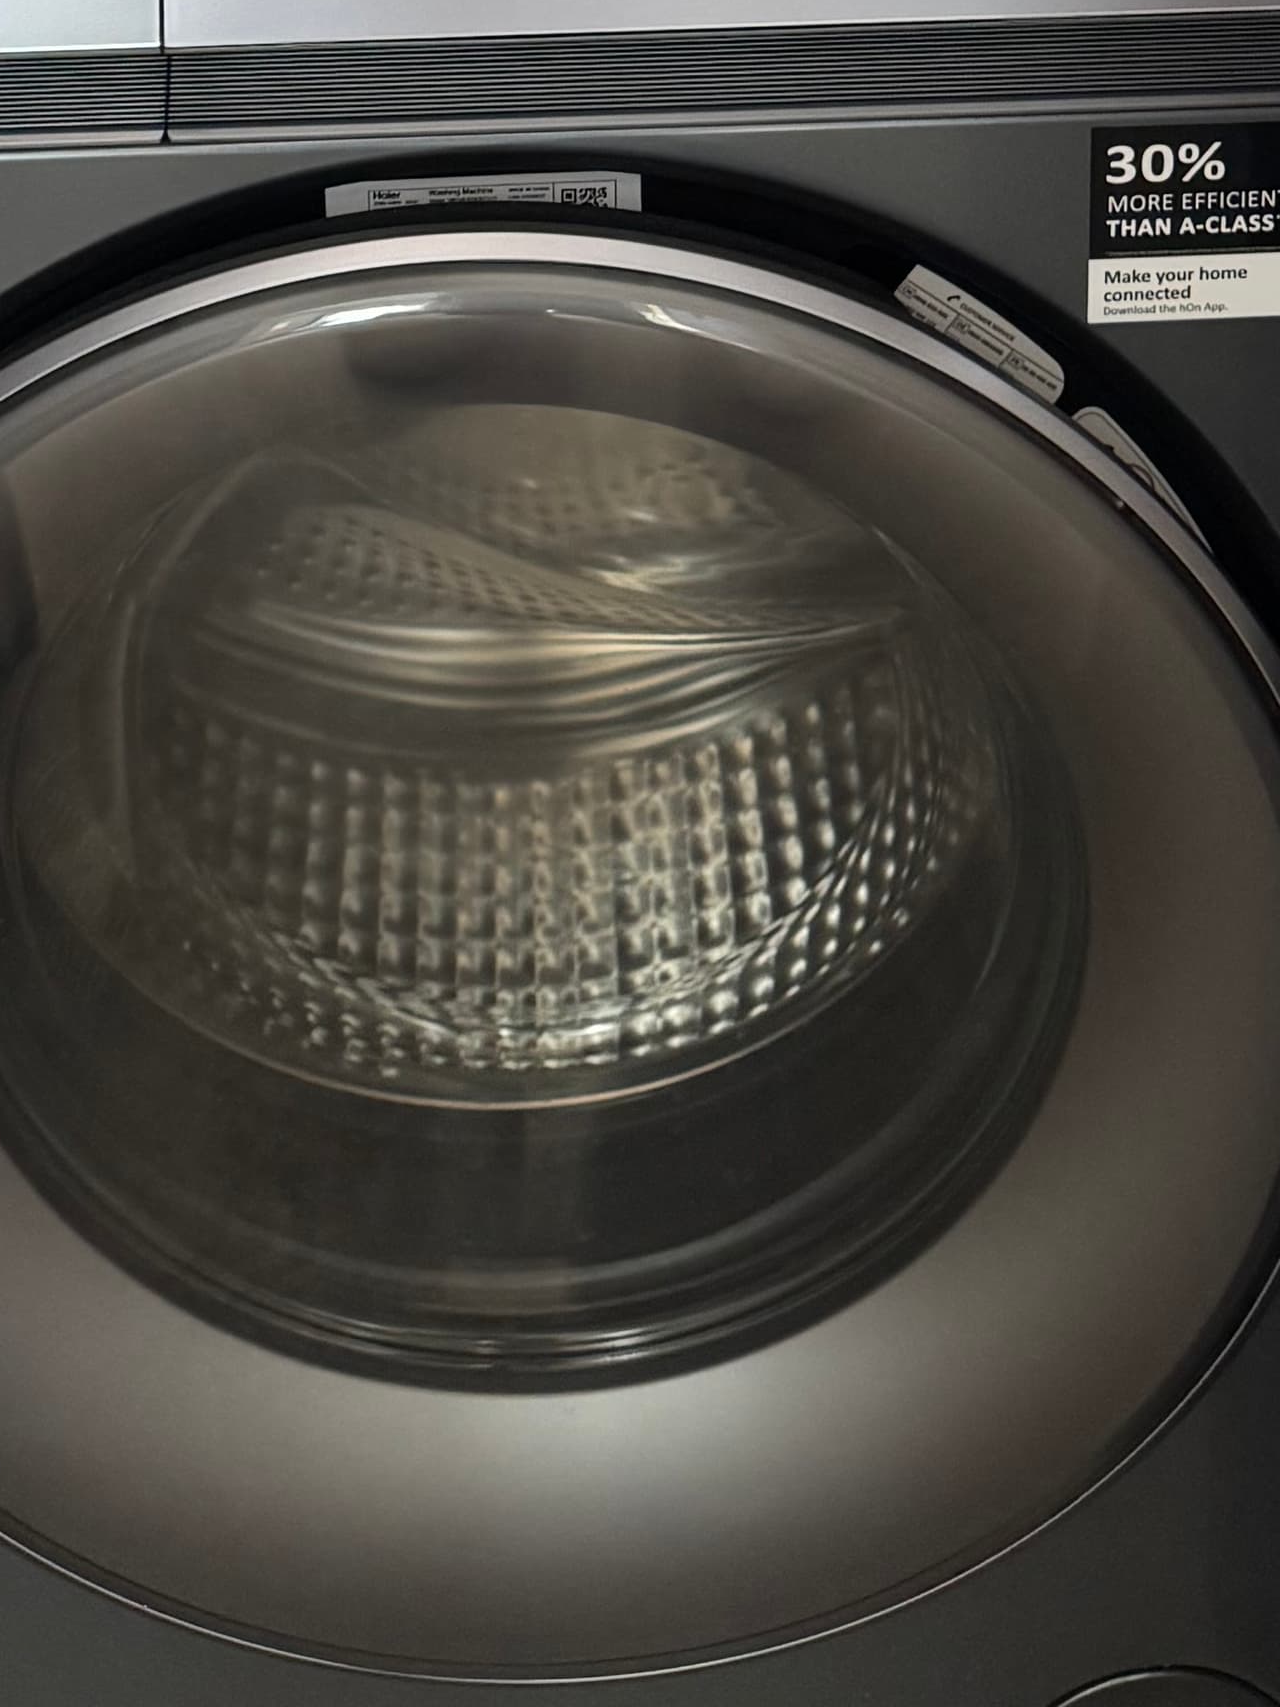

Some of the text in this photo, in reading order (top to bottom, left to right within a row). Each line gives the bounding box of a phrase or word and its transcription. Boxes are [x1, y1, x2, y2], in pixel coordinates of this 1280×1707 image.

[1105, 141, 1227, 185] 30%
[373, 191, 401, 201] Haier
[1107, 193, 1174, 214] MORE
[1106, 217, 1172, 238] THAN
[1103, 266, 1248, 287] Make your home
[1103, 285, 1192, 302] connected
[1103, 300, 1229, 317] Download the hOn App.
